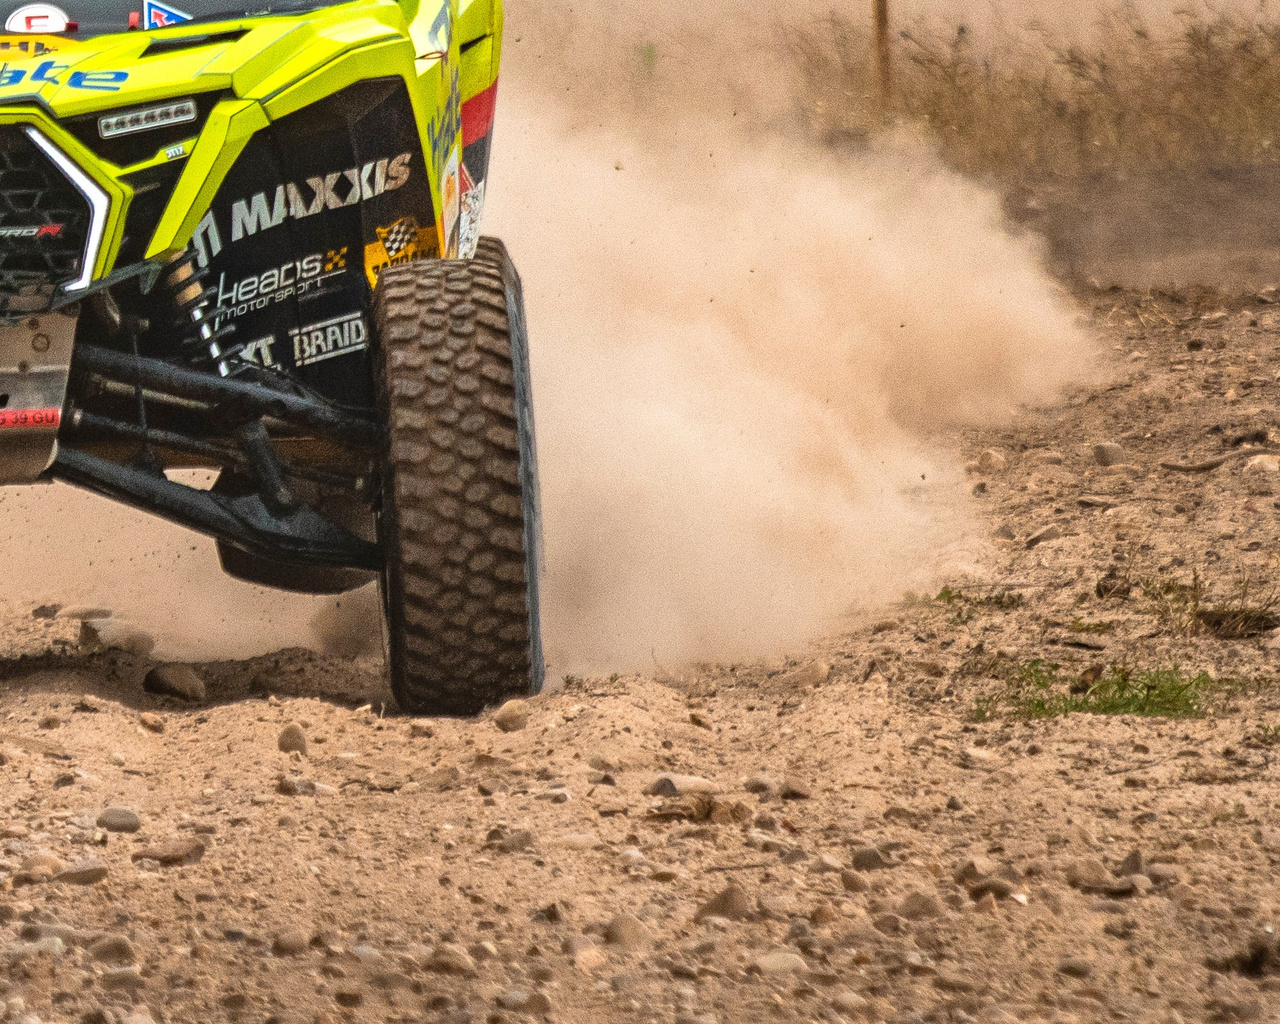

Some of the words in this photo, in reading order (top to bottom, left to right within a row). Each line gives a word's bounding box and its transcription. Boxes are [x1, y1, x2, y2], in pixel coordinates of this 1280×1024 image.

[232, 152, 412, 242] MAXXIS
[292, 318, 367, 360] BRAID
[32, 411, 56, 424] GU
